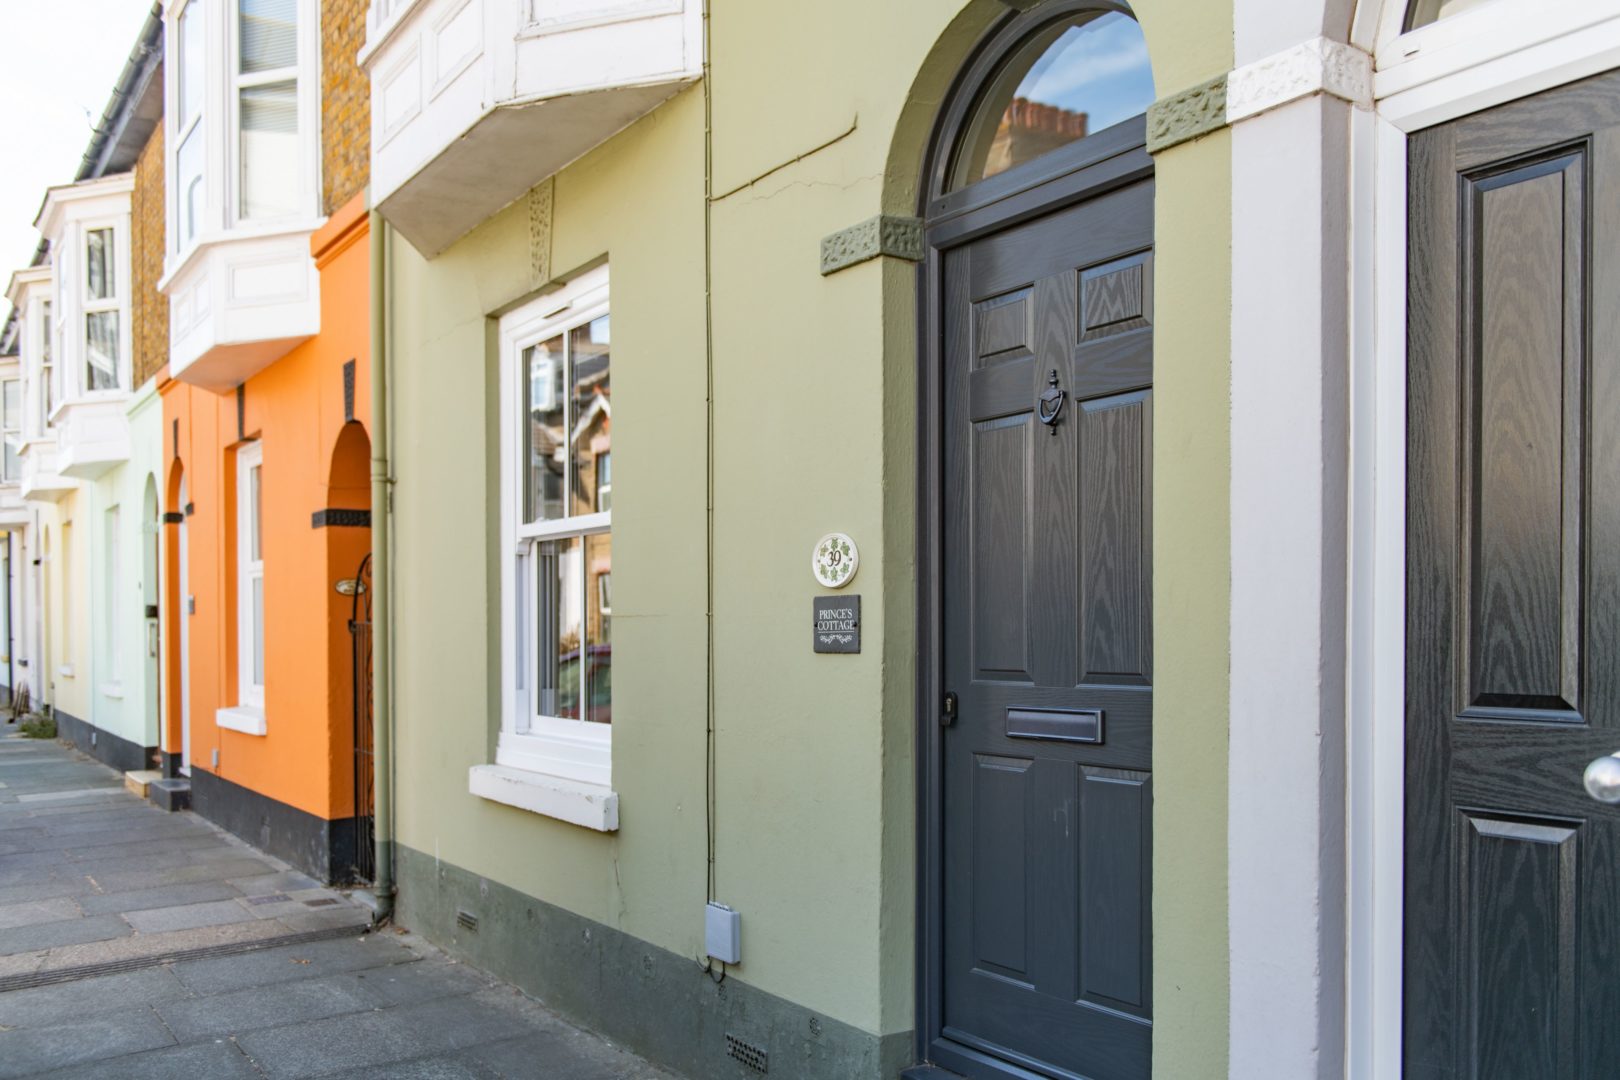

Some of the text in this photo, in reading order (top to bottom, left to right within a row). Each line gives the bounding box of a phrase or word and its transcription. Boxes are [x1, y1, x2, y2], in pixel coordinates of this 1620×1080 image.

[827, 550, 842, 567] 39
[819, 608, 853, 620] PRINCE'S
[817, 619, 855, 631] COTTAGE
